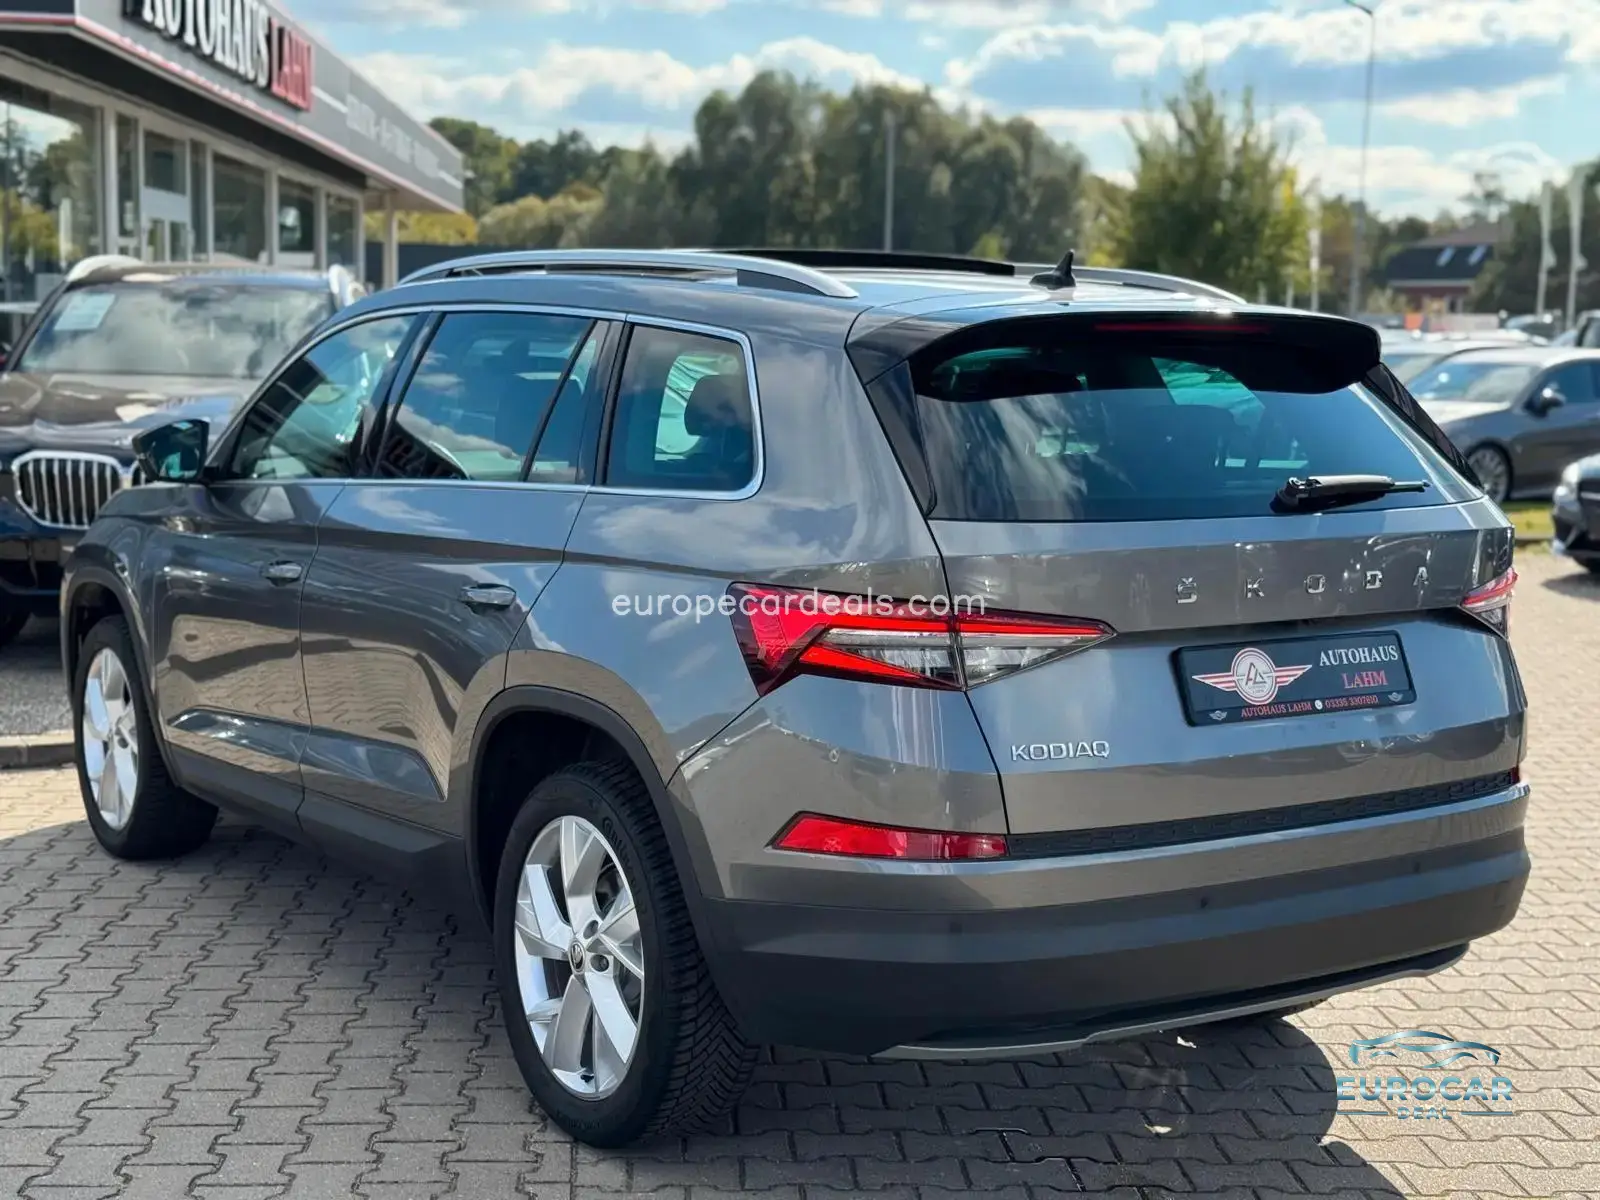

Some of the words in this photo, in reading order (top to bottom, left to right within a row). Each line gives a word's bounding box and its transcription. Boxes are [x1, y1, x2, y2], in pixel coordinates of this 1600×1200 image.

[1319, 645, 1399, 666] AUTOHAUS
[1341, 670, 1388, 689] LAHM
[1241, 703, 1287, 718] AUTOHAUS
[1288, 701, 1312, 712] LAHM
[1010, 740, 1110, 761] KODIAQ
